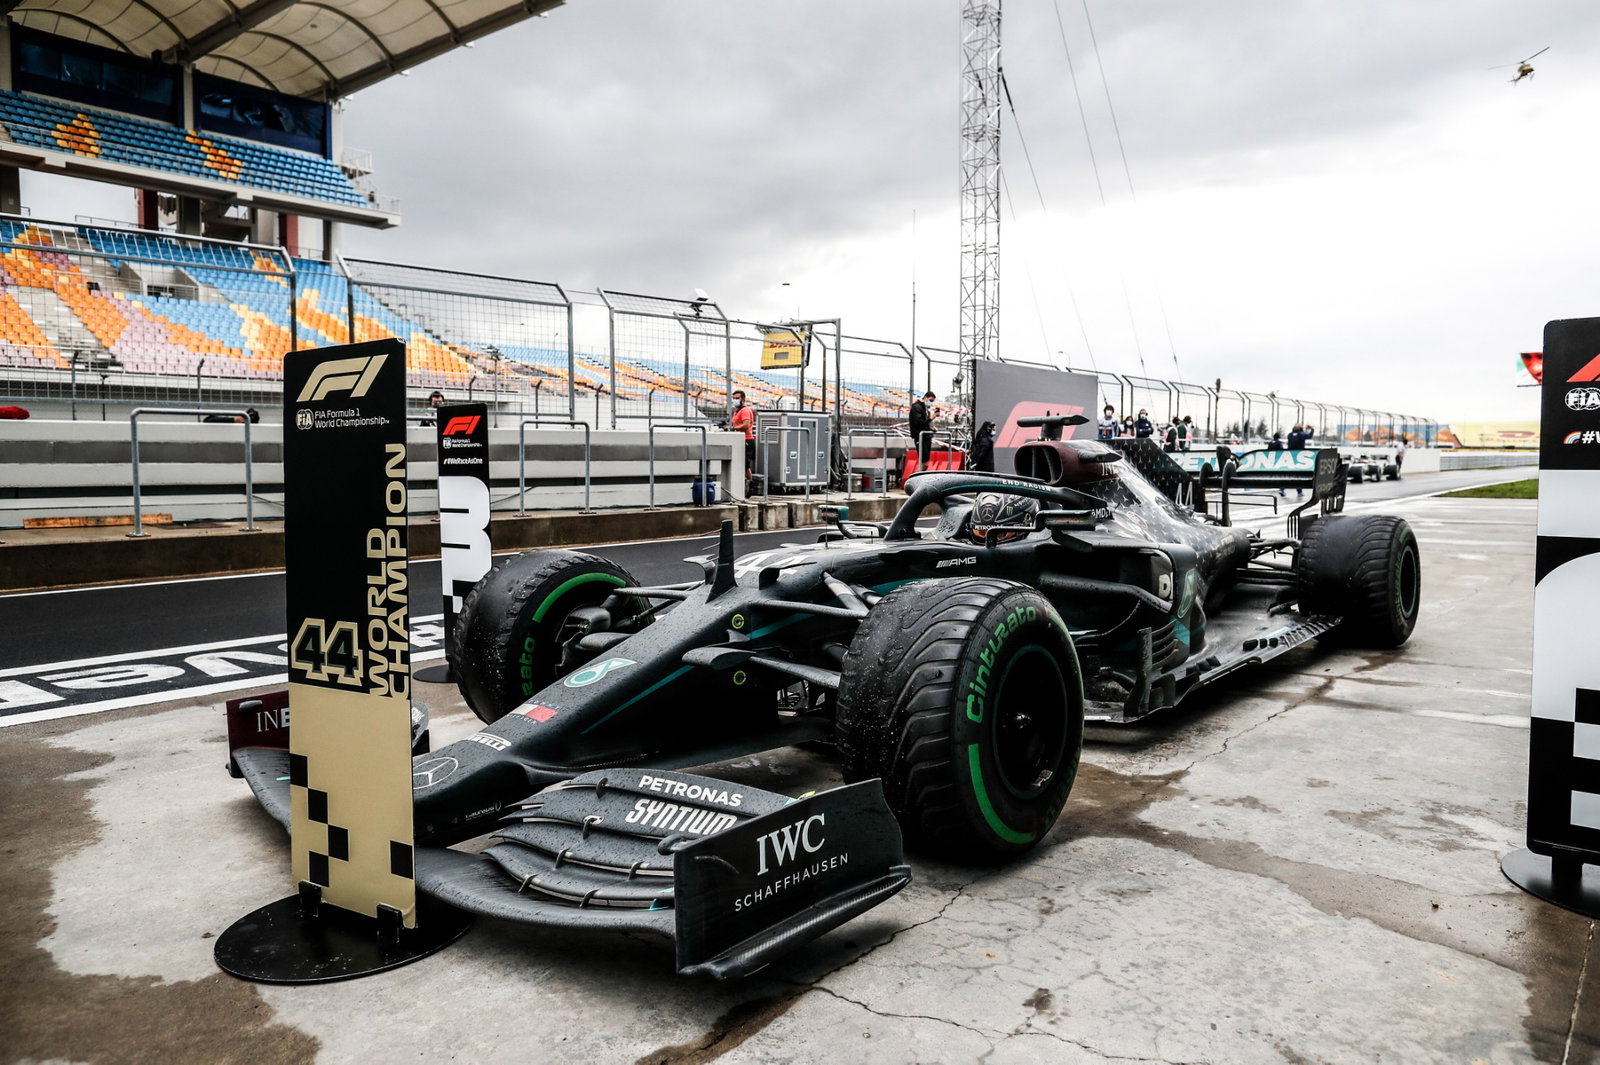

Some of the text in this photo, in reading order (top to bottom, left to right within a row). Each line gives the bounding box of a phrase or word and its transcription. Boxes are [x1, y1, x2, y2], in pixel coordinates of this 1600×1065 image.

[314, 407, 361, 419] FIA Formula 1
[314, 419, 335, 429] World
[1002, 479, 1052, 492] END RACISM
[385, 443, 409, 700] CHAMPION
[948, 557, 977, 566] AMG
[366, 528, 389, 697] WORLD
[291, 617, 364, 686] 44
[638, 775, 743, 807] PETRONAS
[625, 798, 738, 835] SYNTIUM
[756, 813, 825, 876] IWC
[734, 852, 848, 912] SCHAFFHAUSEN
